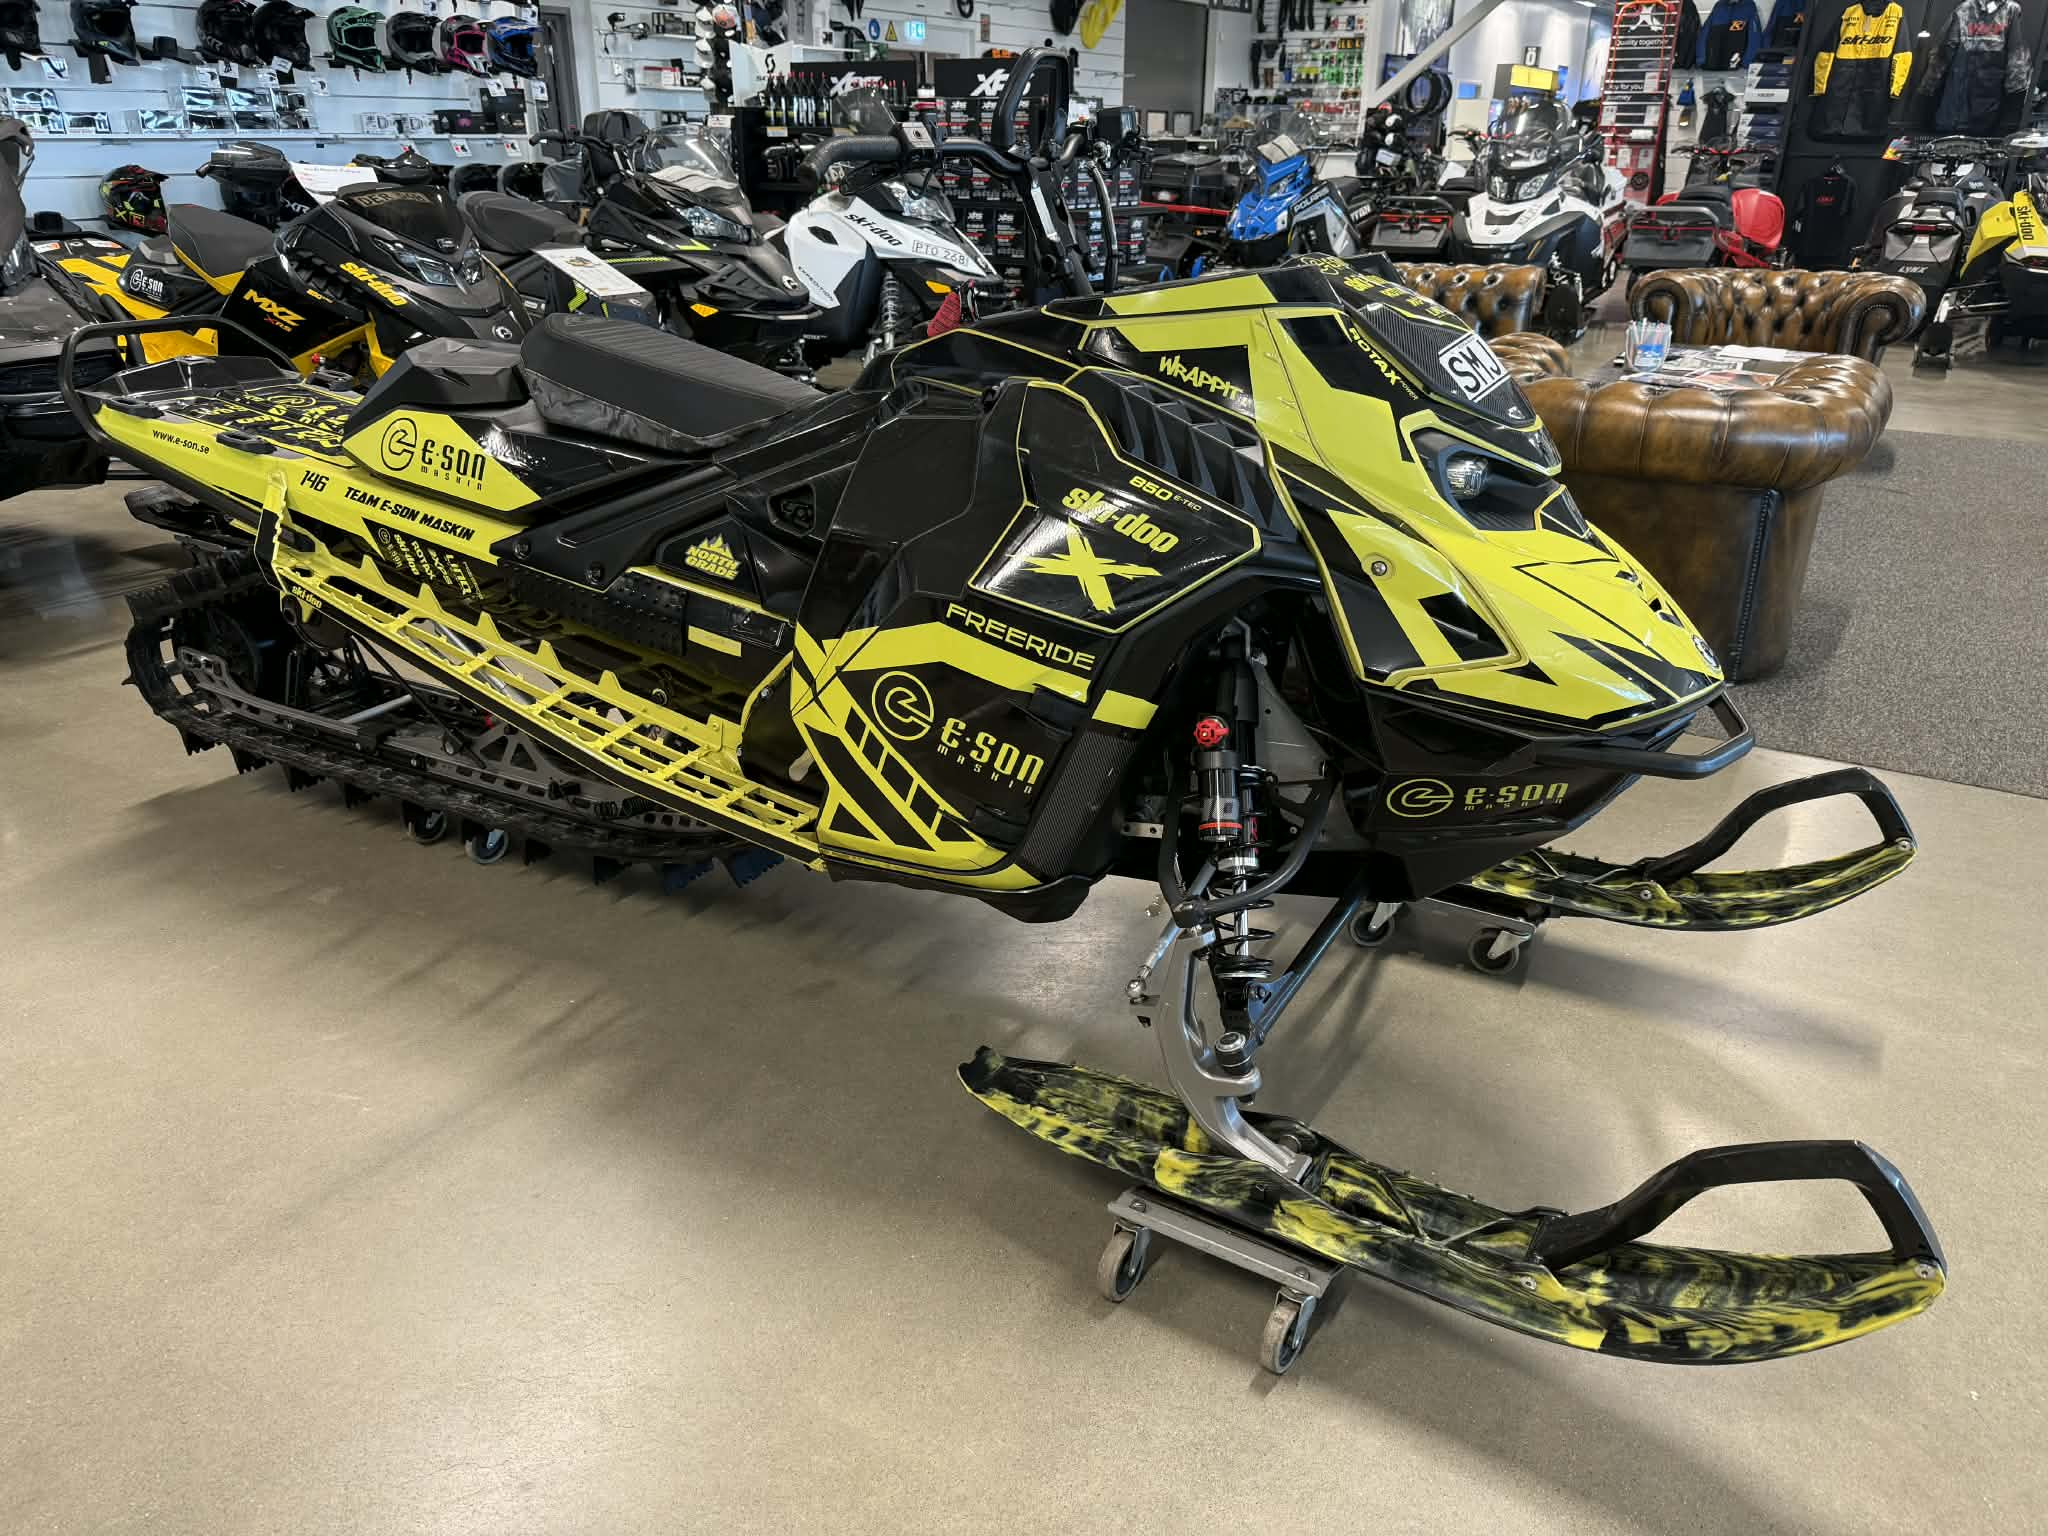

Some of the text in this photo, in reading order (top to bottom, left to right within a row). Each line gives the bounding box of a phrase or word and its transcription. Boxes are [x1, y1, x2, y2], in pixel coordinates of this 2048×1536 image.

[844, 213, 903, 247] ski-doo
[2016, 205, 2034, 241] ski-doo
[943, 249, 966, 265] 268
[1897, 265, 1928, 274] LYNX
[339, 262, 409, 307] ski-doo
[243, 289, 307, 327] MXZ
[1349, 327, 1401, 386] ROTAX
[1448, 339, 1502, 393] SMJ
[152, 429, 210, 455] www.e-son.se
[299, 470, 330, 493] 146
[1129, 475, 1174, 502] 850
[344, 486, 476, 541] TEAM E-SON MASKIN
[1061, 487, 1179, 553] ski-doo
[411, 541, 436, 580] ROTAX
[685, 545, 742, 571] NORTH
[685, 555, 739, 581] GRADE
[291, 585, 323, 609] ski-doo
[945, 602, 1097, 670] FREERIDE
